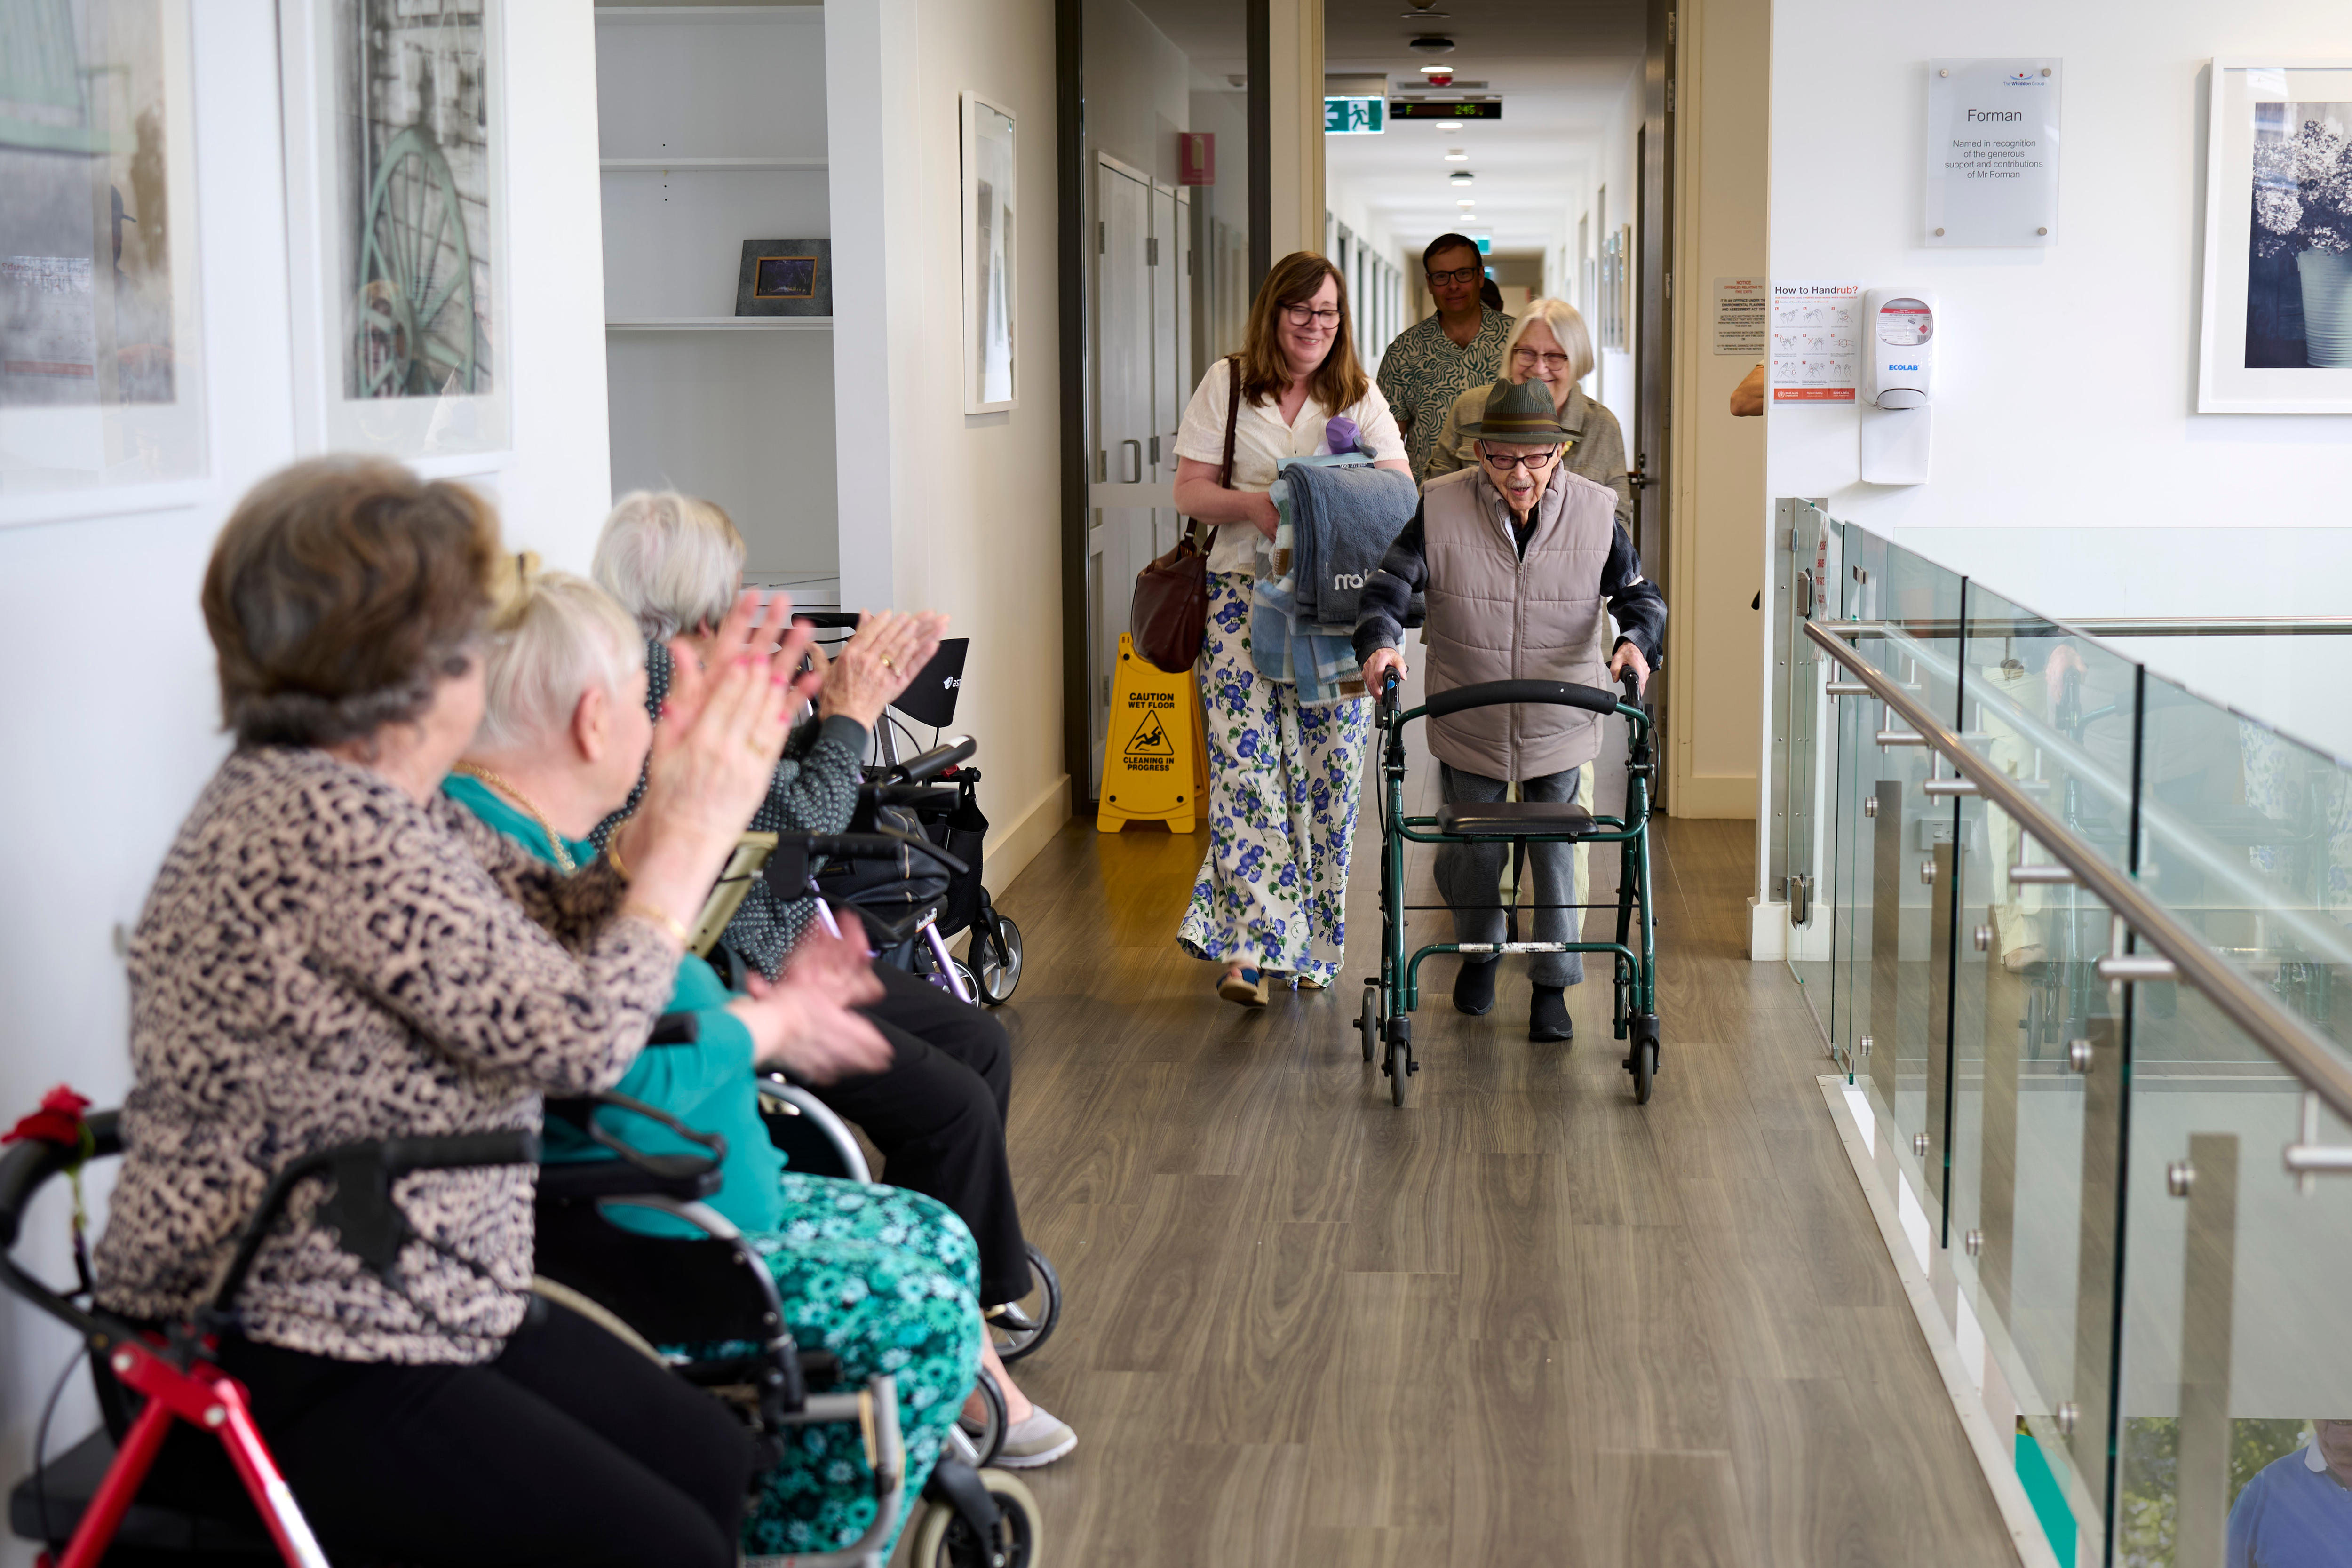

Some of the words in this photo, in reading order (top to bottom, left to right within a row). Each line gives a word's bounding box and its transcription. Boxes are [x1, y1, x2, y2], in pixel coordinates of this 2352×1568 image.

[1968, 109, 2022, 122] Forman
[1993, 139, 2036, 149] recognition
[1945, 161, 1974, 169] support
[1812, 286, 1858, 294] Handrub?
